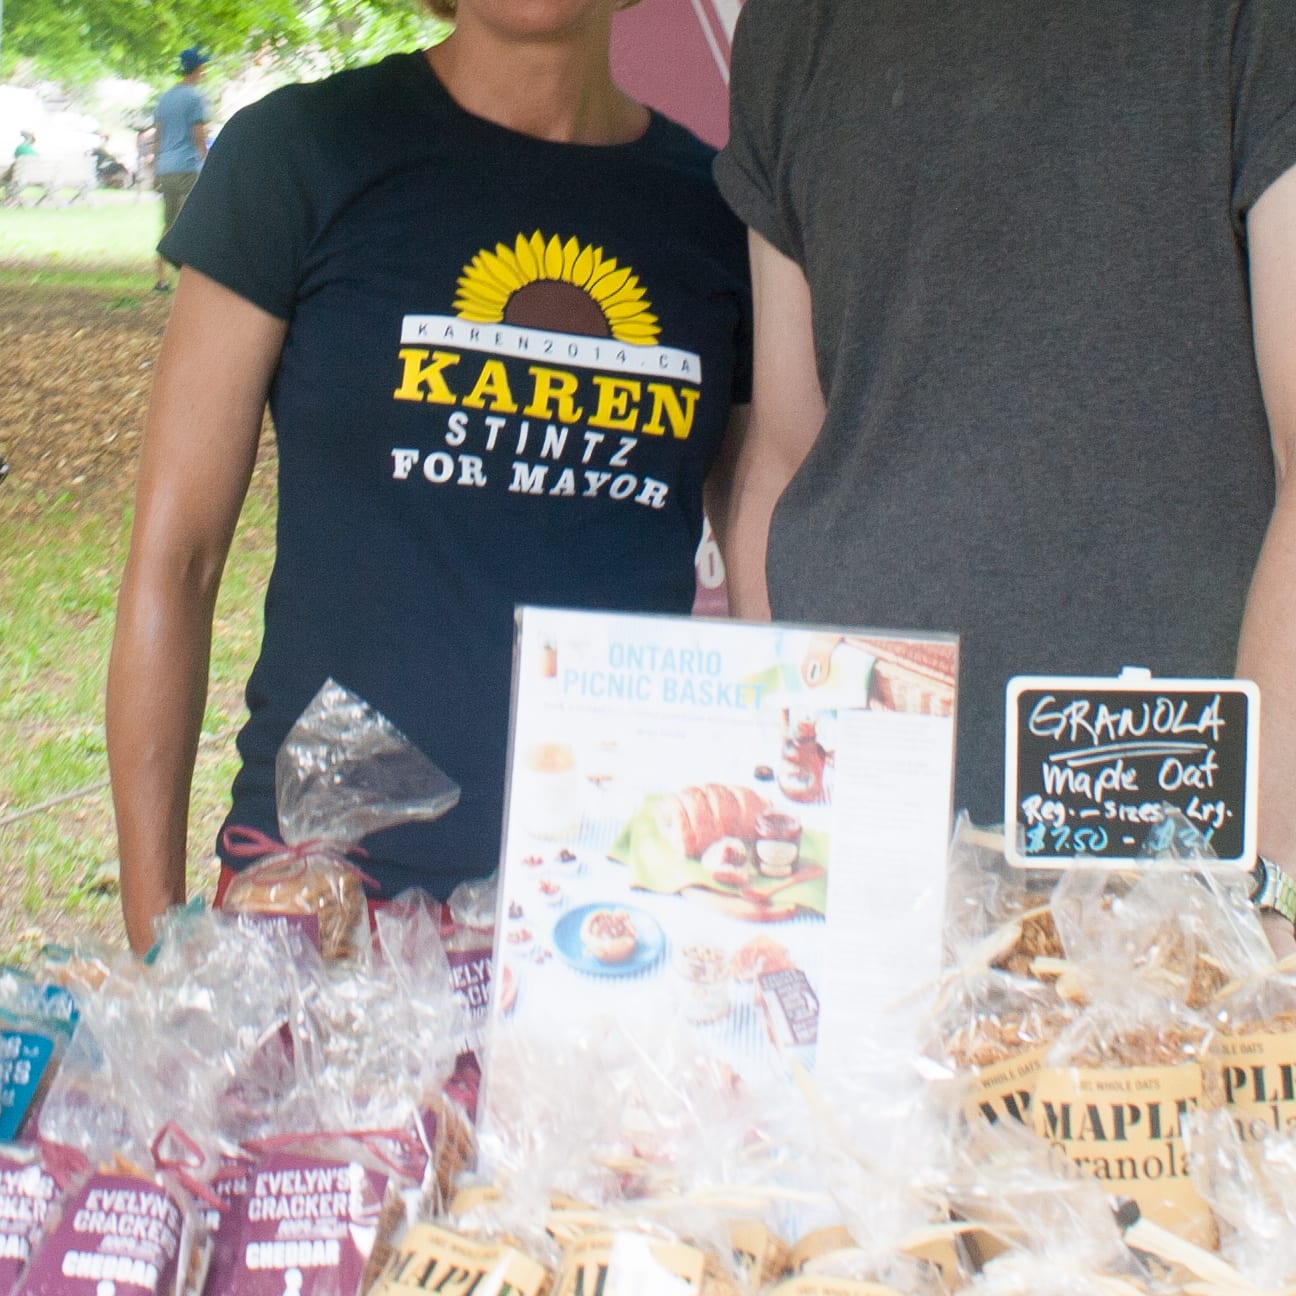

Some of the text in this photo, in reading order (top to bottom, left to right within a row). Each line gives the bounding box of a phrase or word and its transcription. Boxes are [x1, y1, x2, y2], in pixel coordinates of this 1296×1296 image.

[393, 348, 701, 440] KAREN
[445, 410, 638, 467] STINTZ
[391, 447, 670, 509] FOR MAYOR
[607, 642, 724, 678] ONTARIO
[563, 669, 767, 710] PICNIC BASKET
[1029, 694, 1226, 746] GRANOLA
[1158, 748, 1219, 791] Oat
[1041, 1095, 1200, 1141] MAPLE
[255, 1166, 350, 1197] EVELYN'S
[248, 1191, 351, 1222] CRACKER
